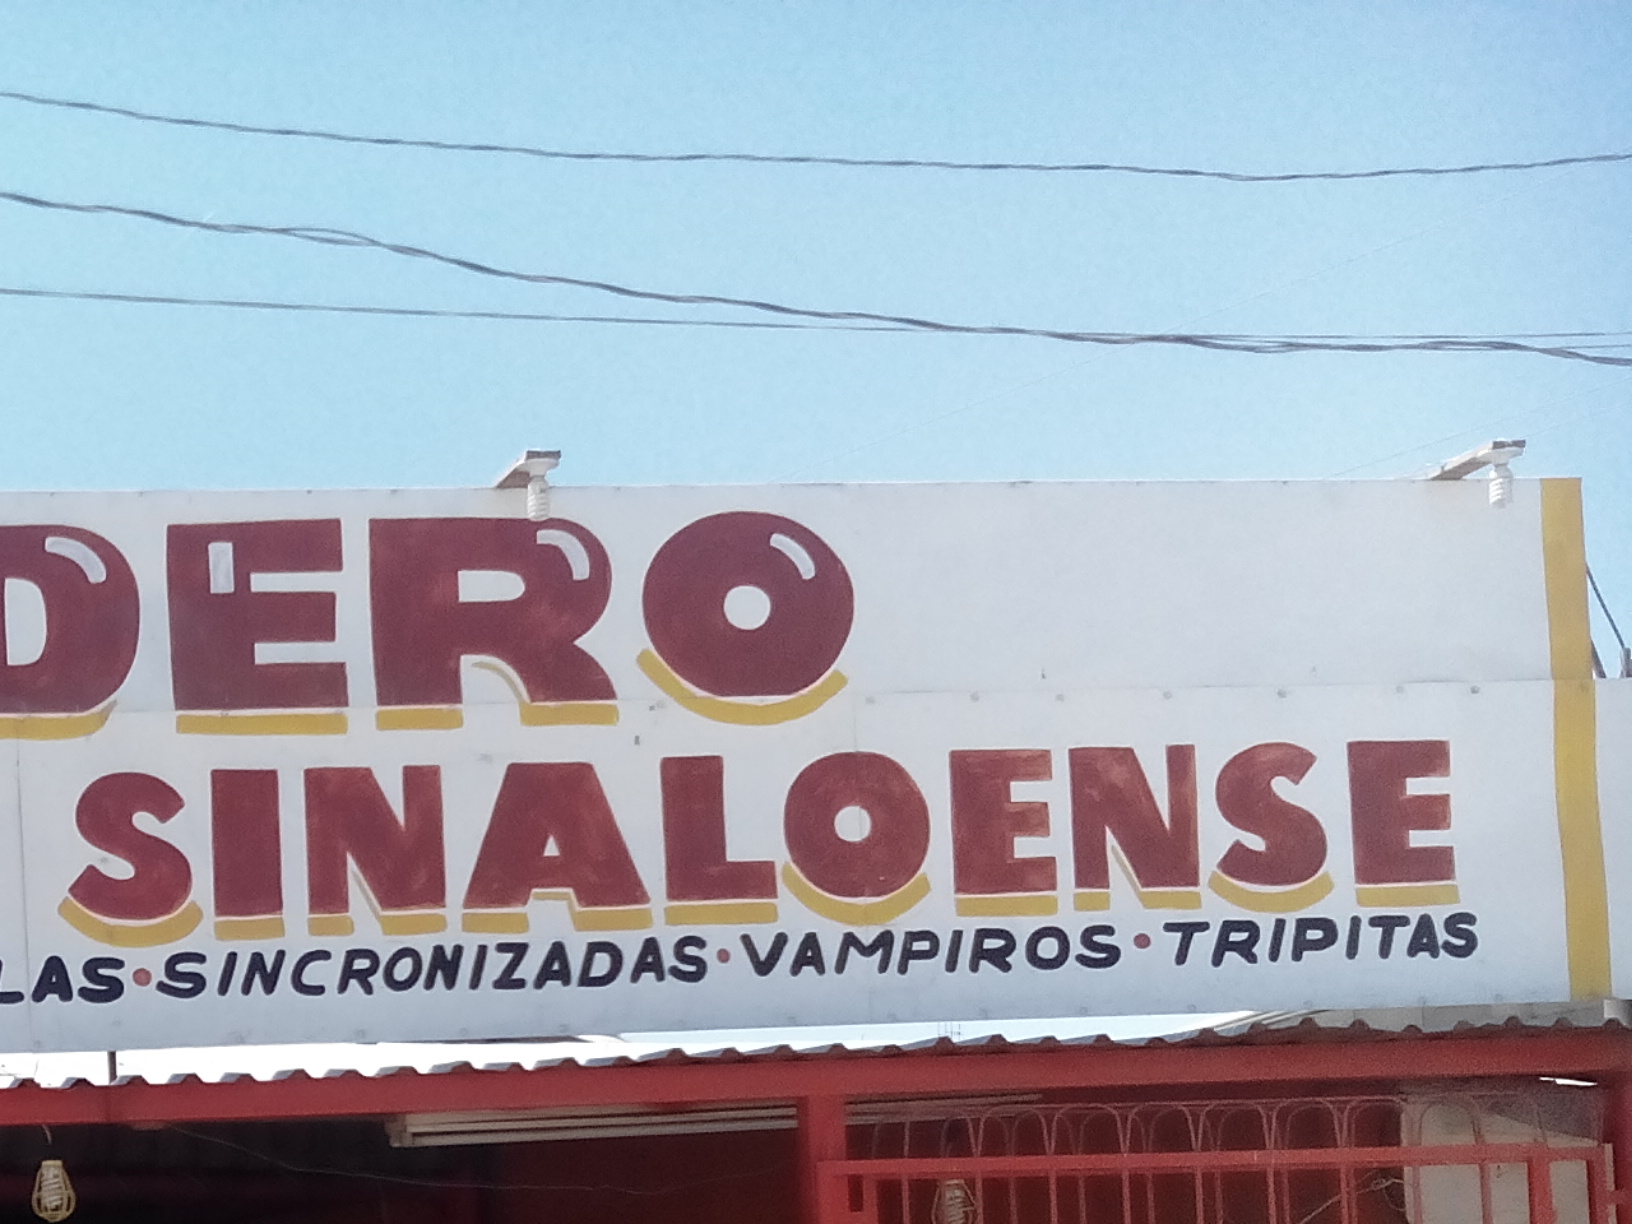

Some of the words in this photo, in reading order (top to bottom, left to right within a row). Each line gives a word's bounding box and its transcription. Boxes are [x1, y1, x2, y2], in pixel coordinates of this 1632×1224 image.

[66, 740, 1457, 923] SINALOENSE
[156, 934, 708, 999] SINCRONIZADAS
[739, 925, 1123, 977] VAMPIROS
[1162, 911, 1480, 967] TRIPITAS
